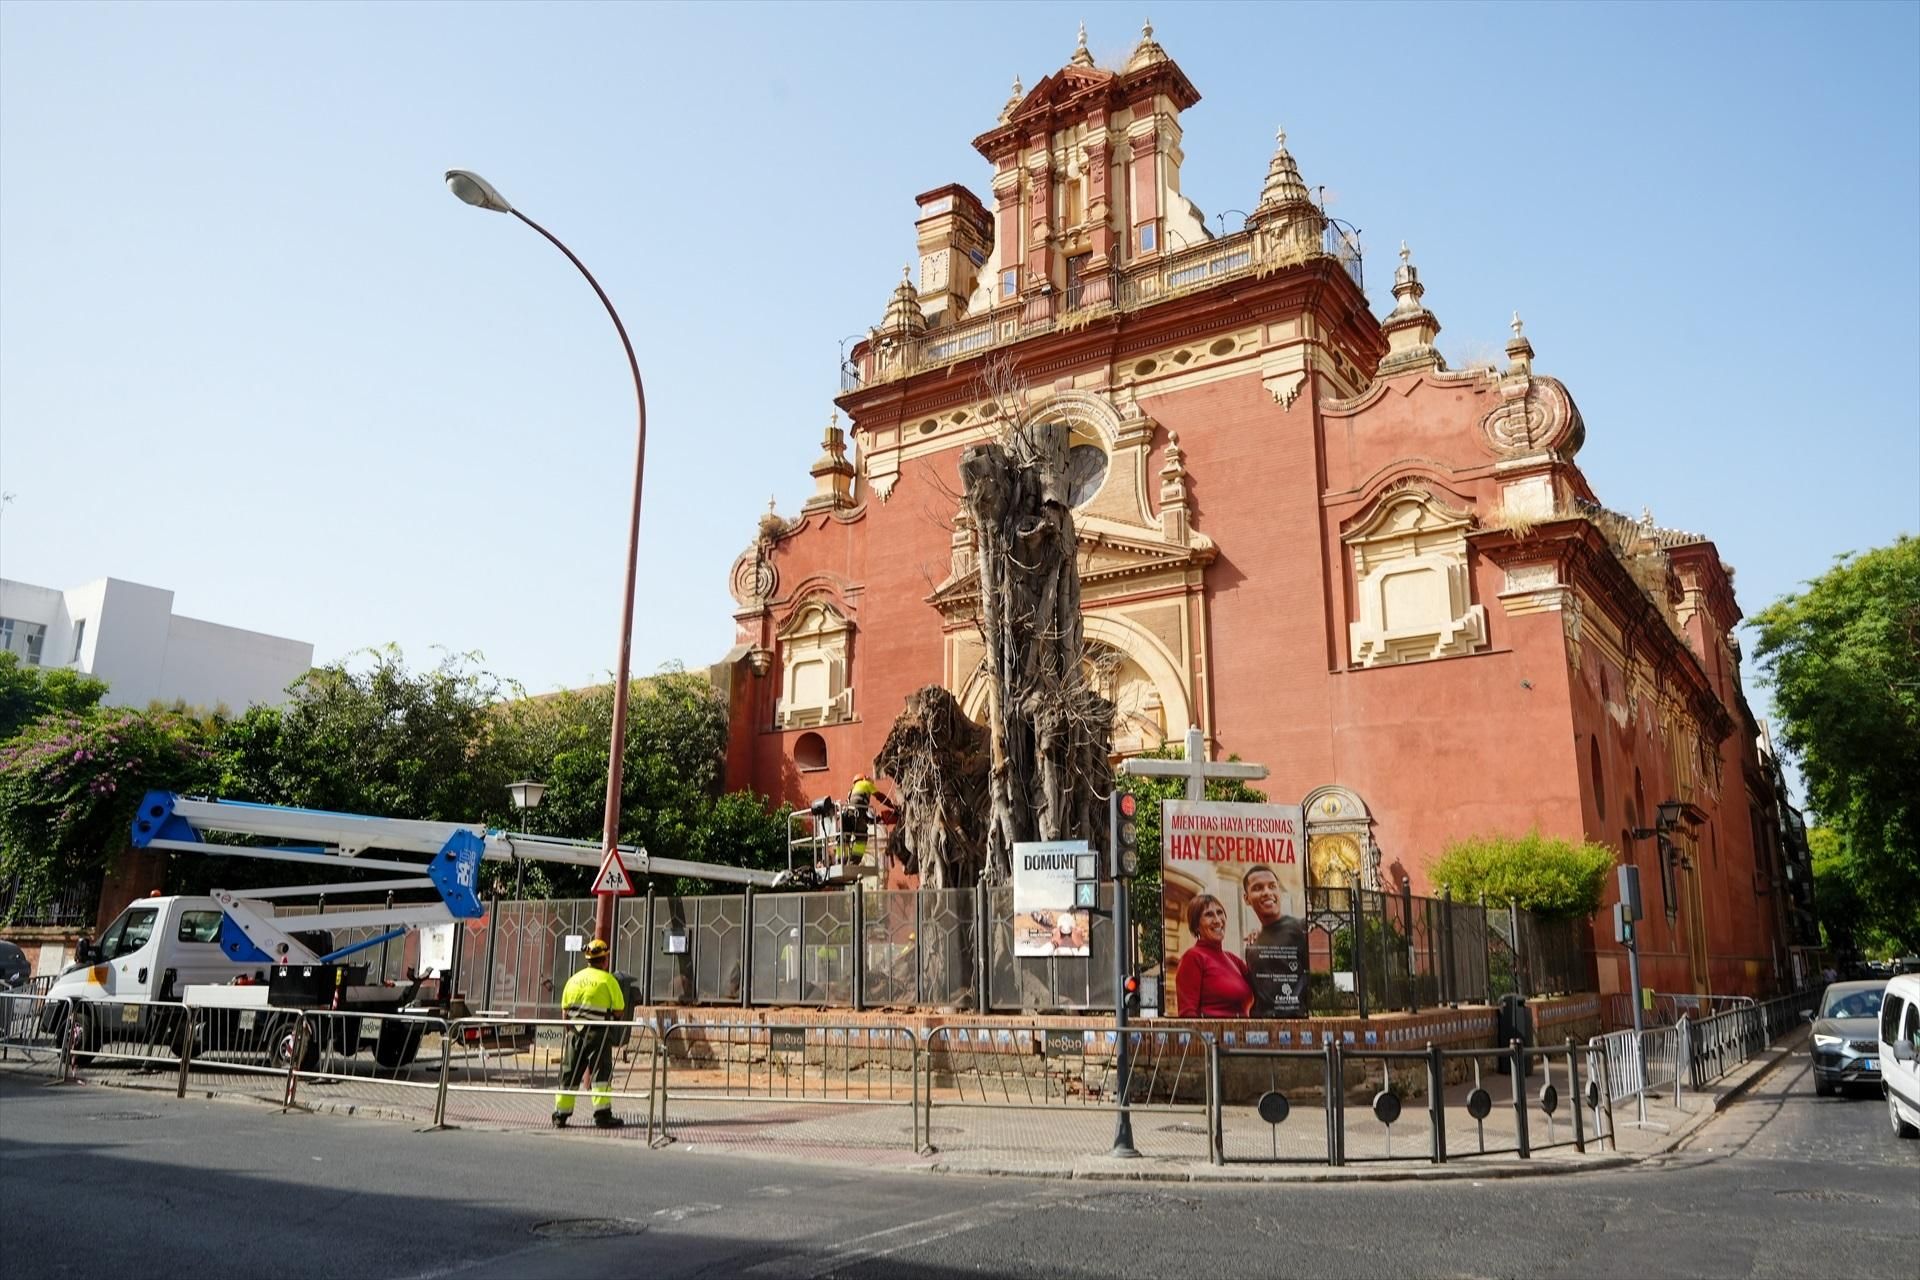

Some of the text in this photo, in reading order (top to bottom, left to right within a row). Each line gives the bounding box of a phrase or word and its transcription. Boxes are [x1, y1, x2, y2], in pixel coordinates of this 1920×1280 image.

[1171, 815, 1218, 831] MIENTRAS
[1220, 817, 1243, 832] HAYA
[1245, 818, 1296, 835] PERSONAS,
[1170, 834, 1296, 864] HAY ESPERANZA
